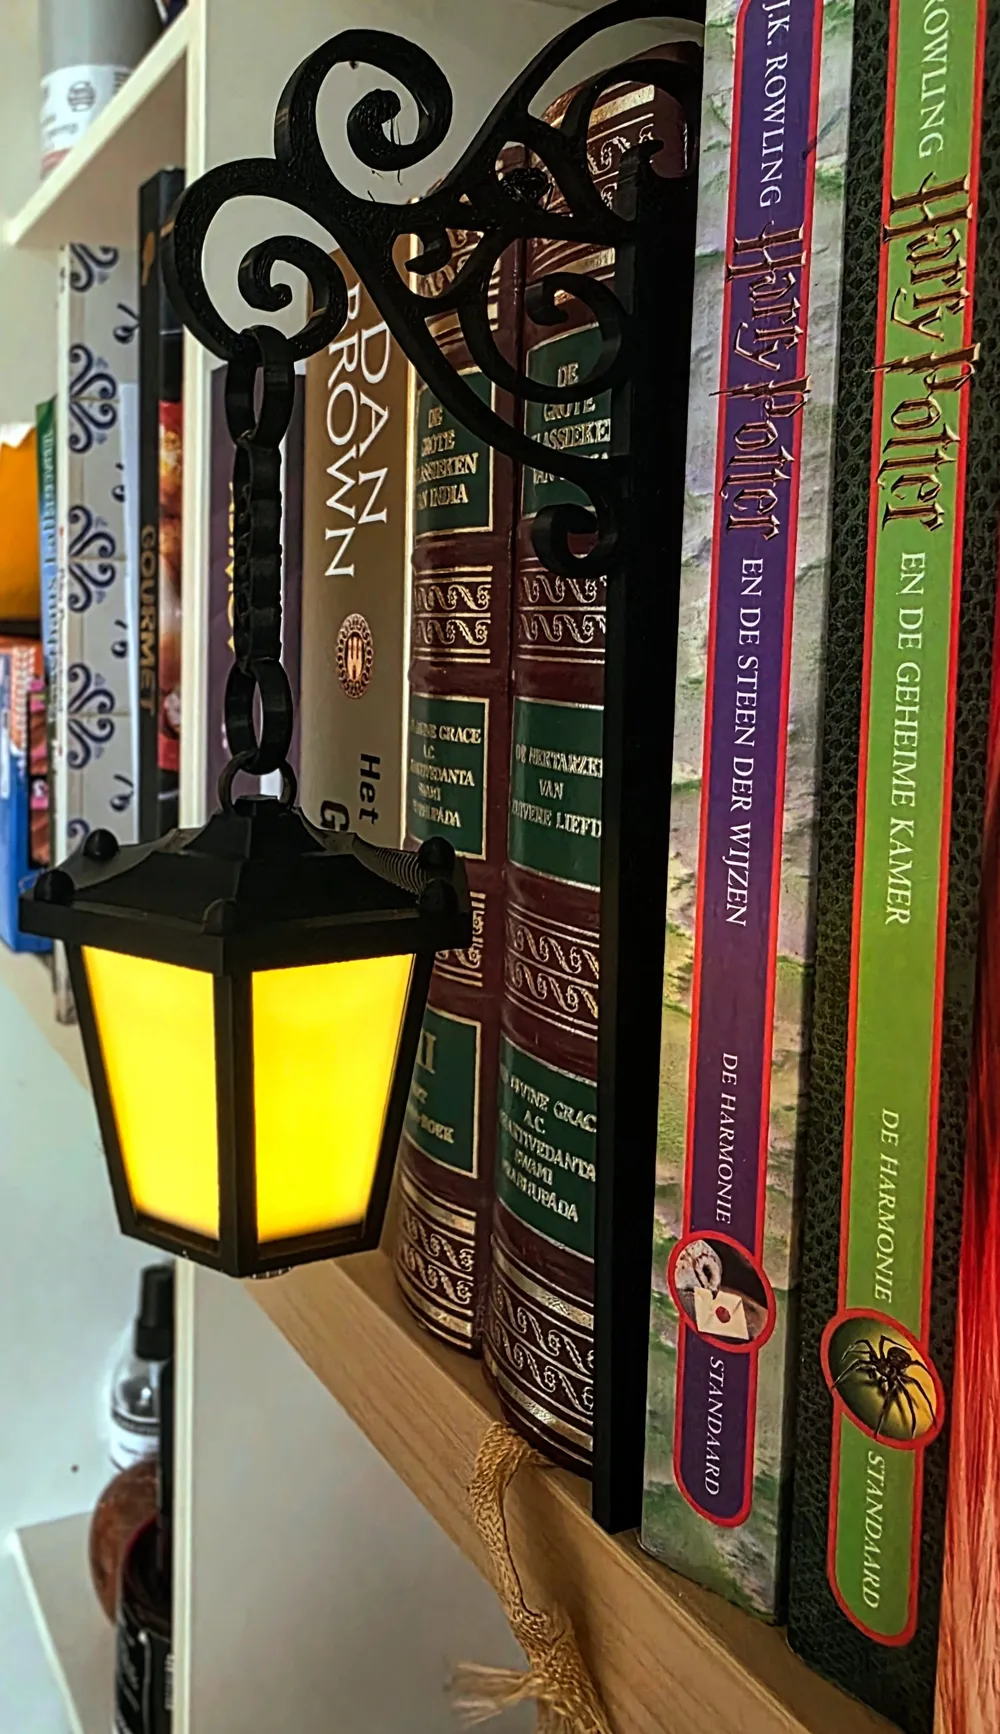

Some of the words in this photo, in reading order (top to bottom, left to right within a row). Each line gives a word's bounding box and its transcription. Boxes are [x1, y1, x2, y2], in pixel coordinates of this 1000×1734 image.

[761, 0, 791, 46] J.K.
[759, 53, 788, 208] ROWLING
[726, 220, 807, 371] Harry
[880, 171, 974, 341] Harry
[357, 321, 390, 524] DAN
[557, 363, 579, 388] DE
[708, 374, 813, 540] Potter
[864, 343, 982, 532] Potter
[139, 524, 157, 717] GOURMET
[738, 607, 761, 645] DE
[740, 557, 763, 597] EN
[898, 552, 926, 597] EN
[897, 607, 924, 649] DE
[438, 725, 482, 744] GRACE
[734, 655, 759, 748] STEEN
[890, 662, 921, 808] GEHEIME
[358, 753, 382, 825] Het
[539, 779, 564, 800] VAN
[730, 756, 754, 812] DER
[723, 821, 752, 927] WIJZEN
[884, 817, 914, 925] KAMER
[722, 1052, 738, 1085] DE
[716, 1092, 736, 1225] HARMONIE
[881, 1108, 899, 1146] DE
[875, 1153, 898, 1303] HARMONIE
[704, 1356, 724, 1496] STANDAARD
[862, 1450, 885, 1608] STANDAARD
